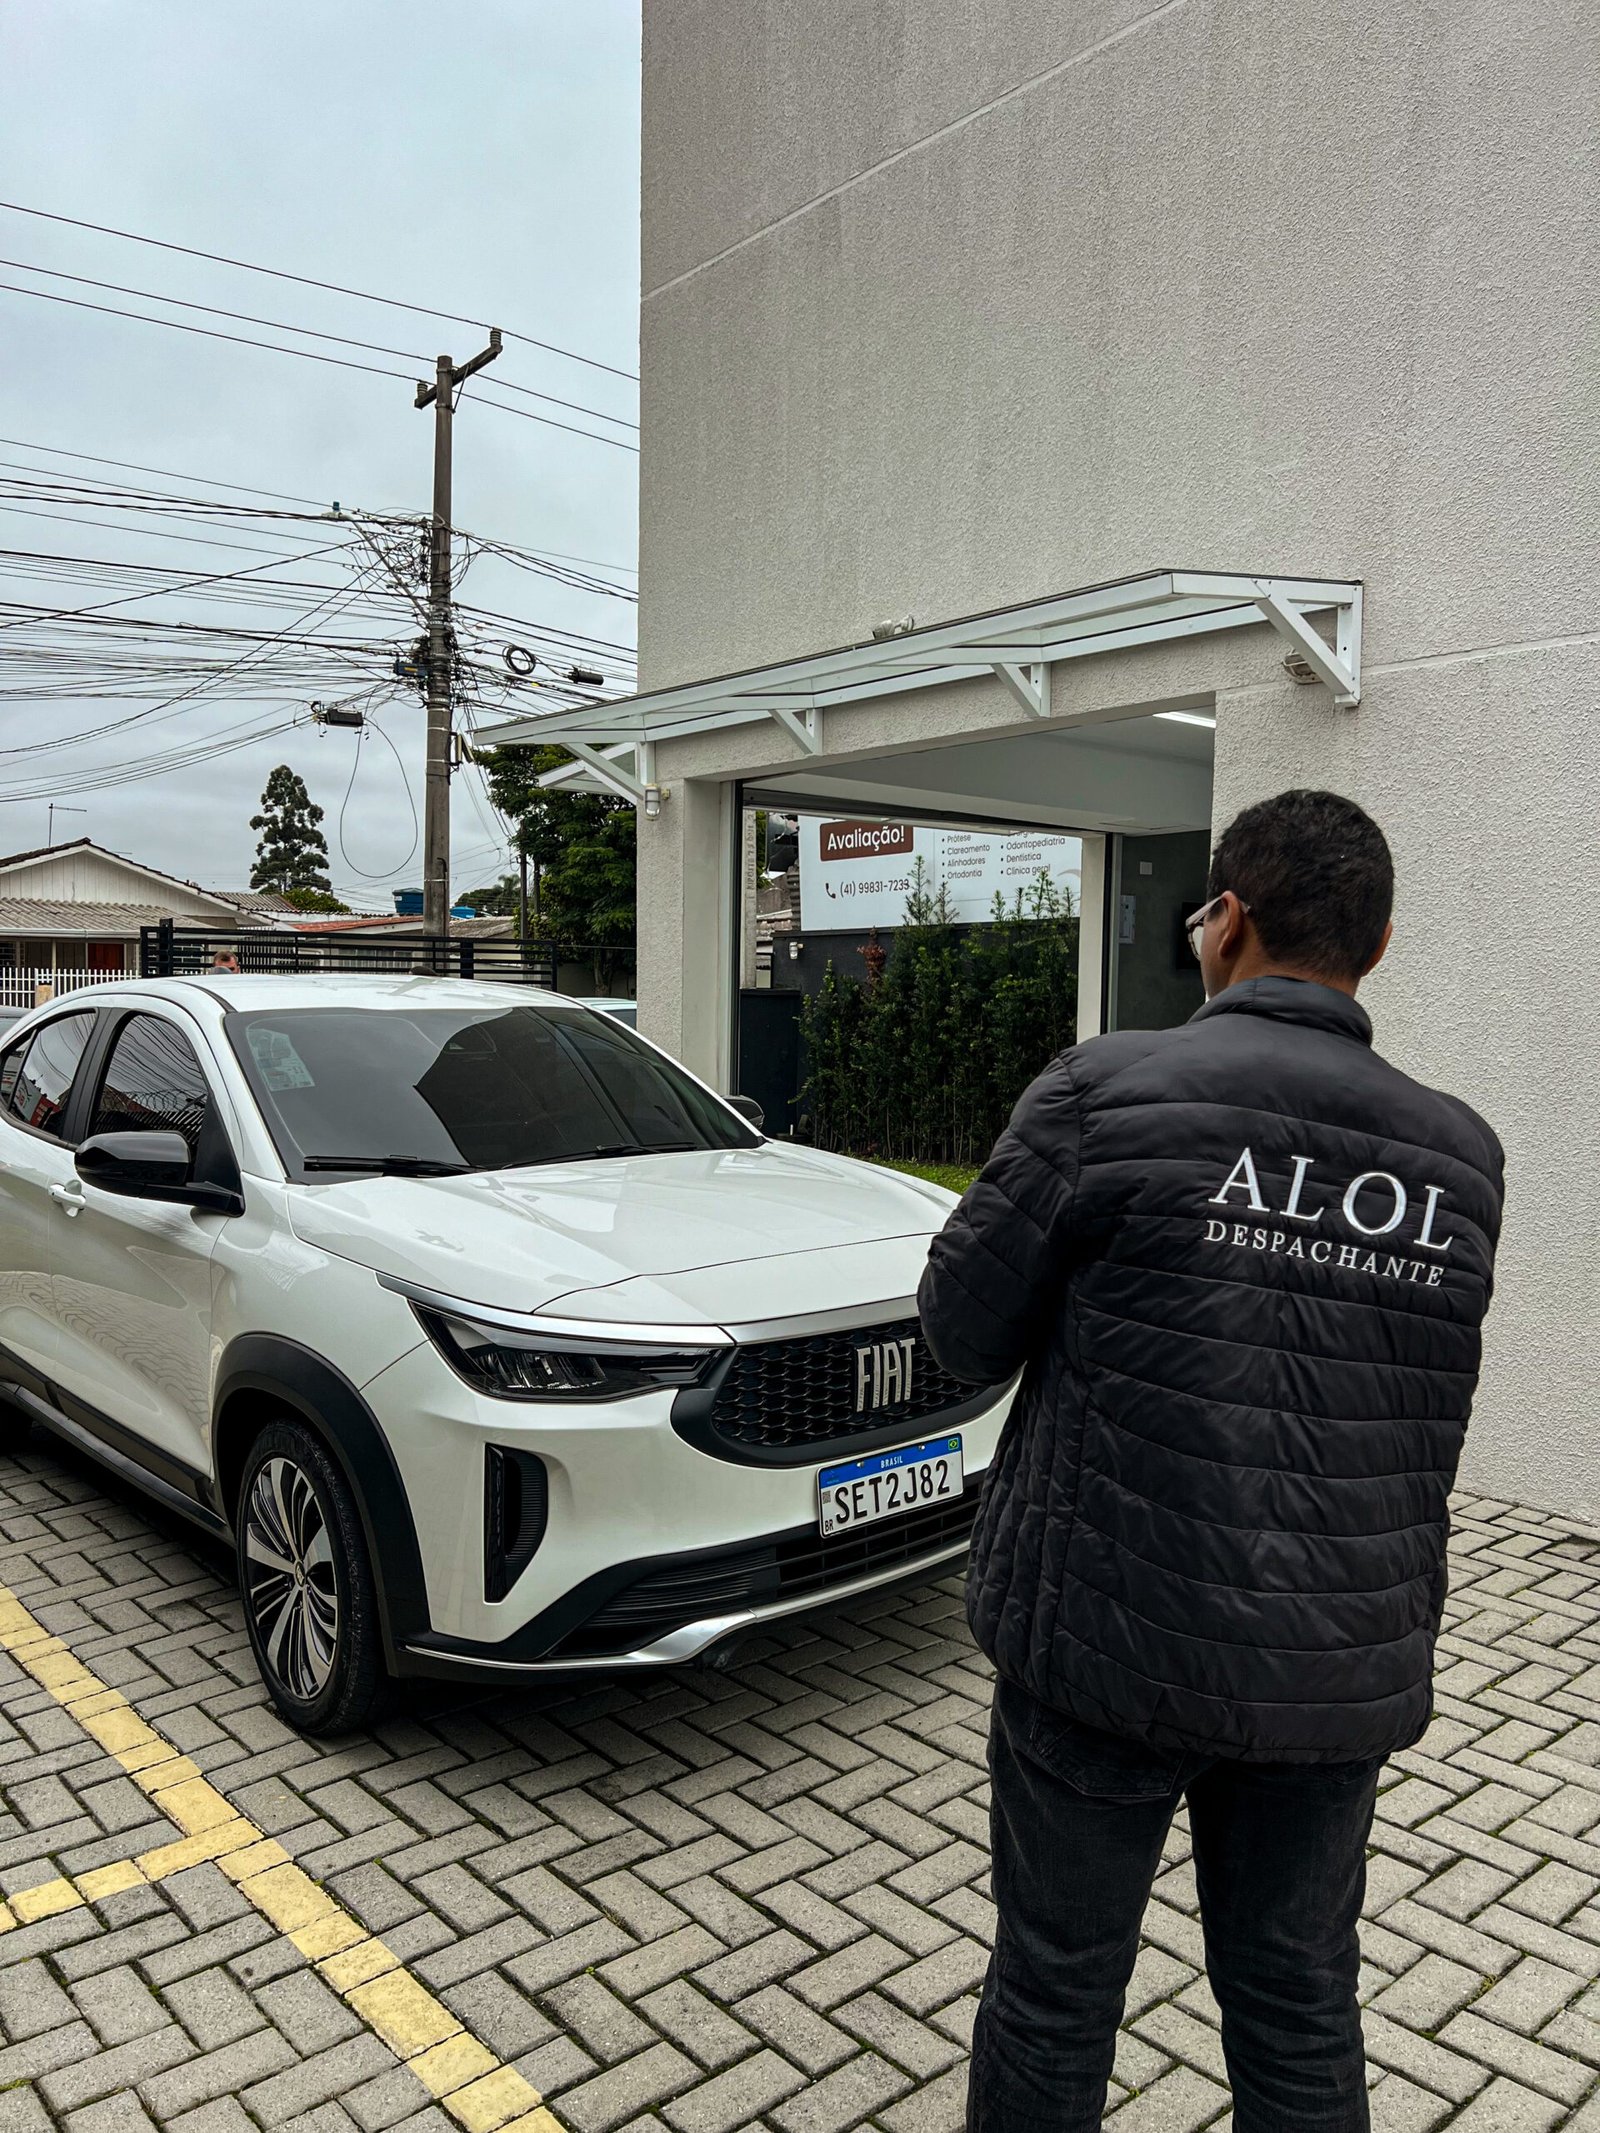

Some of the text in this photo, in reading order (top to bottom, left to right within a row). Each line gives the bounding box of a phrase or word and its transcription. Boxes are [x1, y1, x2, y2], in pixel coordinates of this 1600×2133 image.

[827, 825, 905, 852] Avaliação!
[947, 834, 972, 844] Prótese
[1006, 837, 1066, 852] Odontopediatria
[947, 844, 991, 856] Clareamento
[947, 857, 986, 868] Alinhadores
[947, 869, 983, 880] Ortodontia
[840, 881, 856, 898] (41)
[1208, 1147, 1453, 1251] ALOL
[1204, 1220, 1445, 1287] DESPACHANTE
[856, 1337, 916, 1413] FIAT
[880, 1456, 904, 1469] BRASIL
[834, 1459, 951, 1525] SET2J82
[824, 1519, 835, 1532] BR
